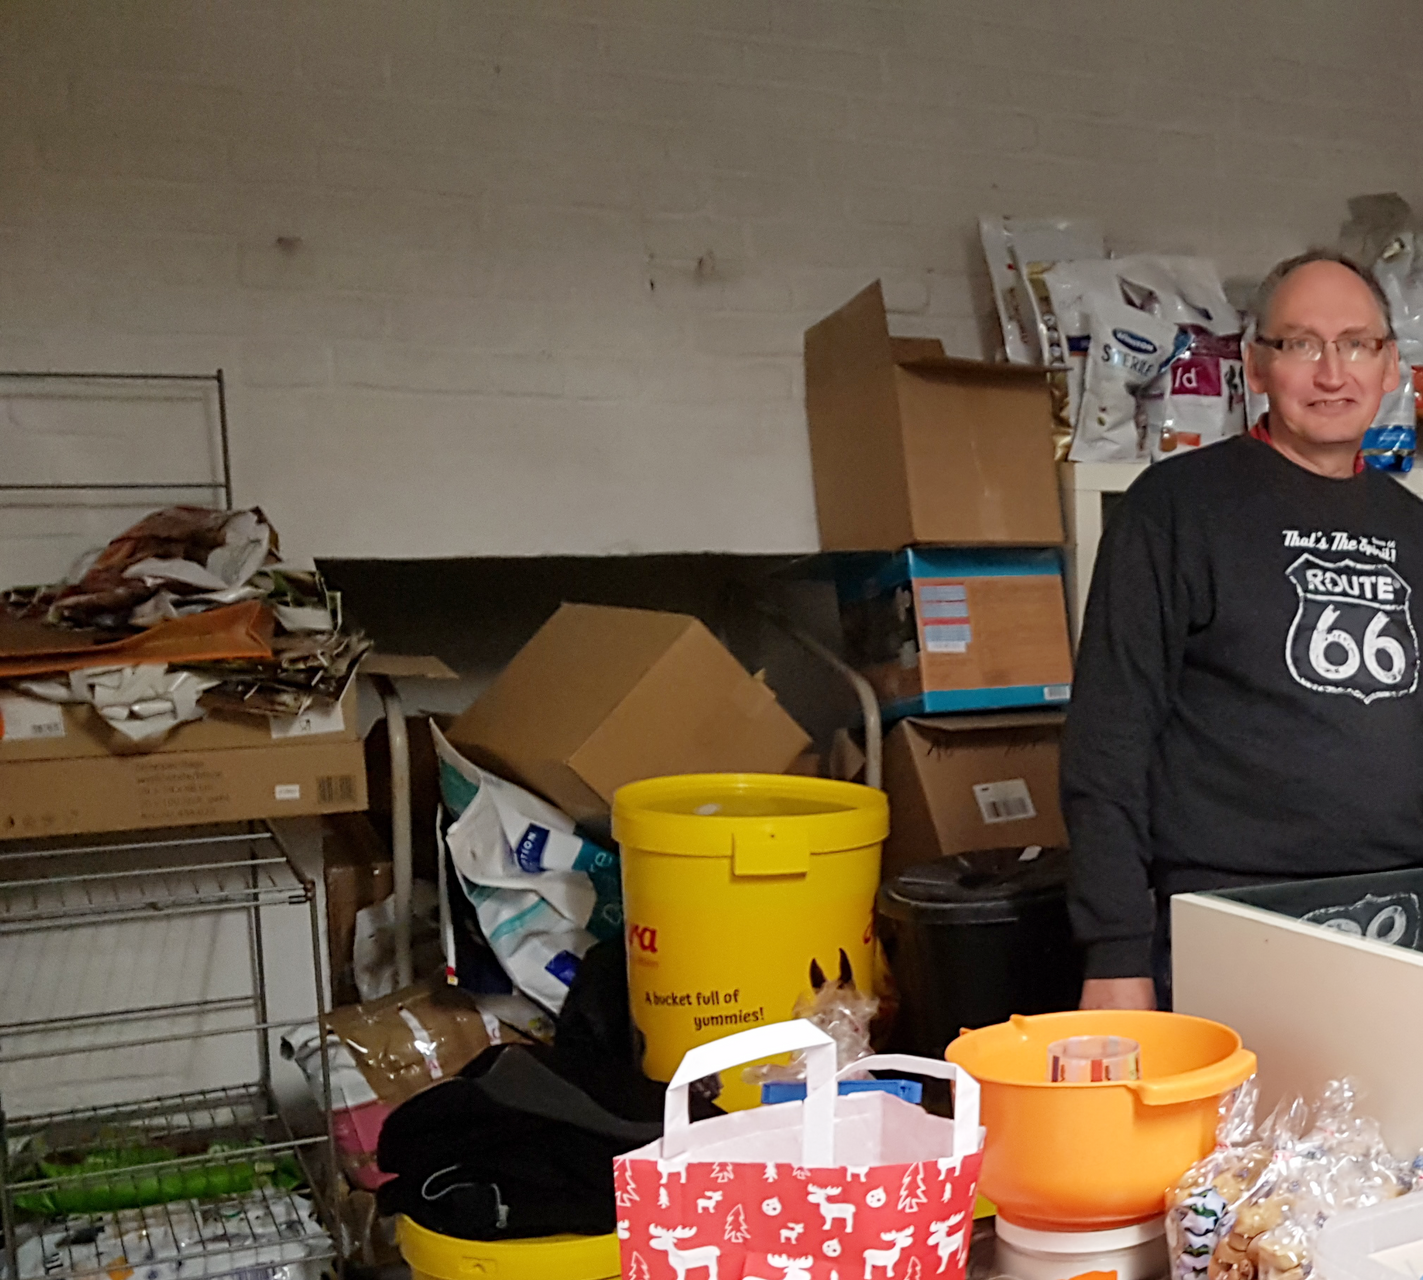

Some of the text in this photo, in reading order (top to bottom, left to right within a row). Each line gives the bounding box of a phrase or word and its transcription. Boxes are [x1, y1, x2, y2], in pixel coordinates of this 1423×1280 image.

[1282, 529, 1329, 549] That's
[1331, 531, 1358, 551] The
[1305, 568, 1395, 601] ROUTE
[1308, 603, 1407, 685] 66
[651, 991, 693, 1007] bucket
[696, 990, 720, 1007] full
[723, 988, 740, 1004] of
[693, 1006, 765, 1032] yummies!
